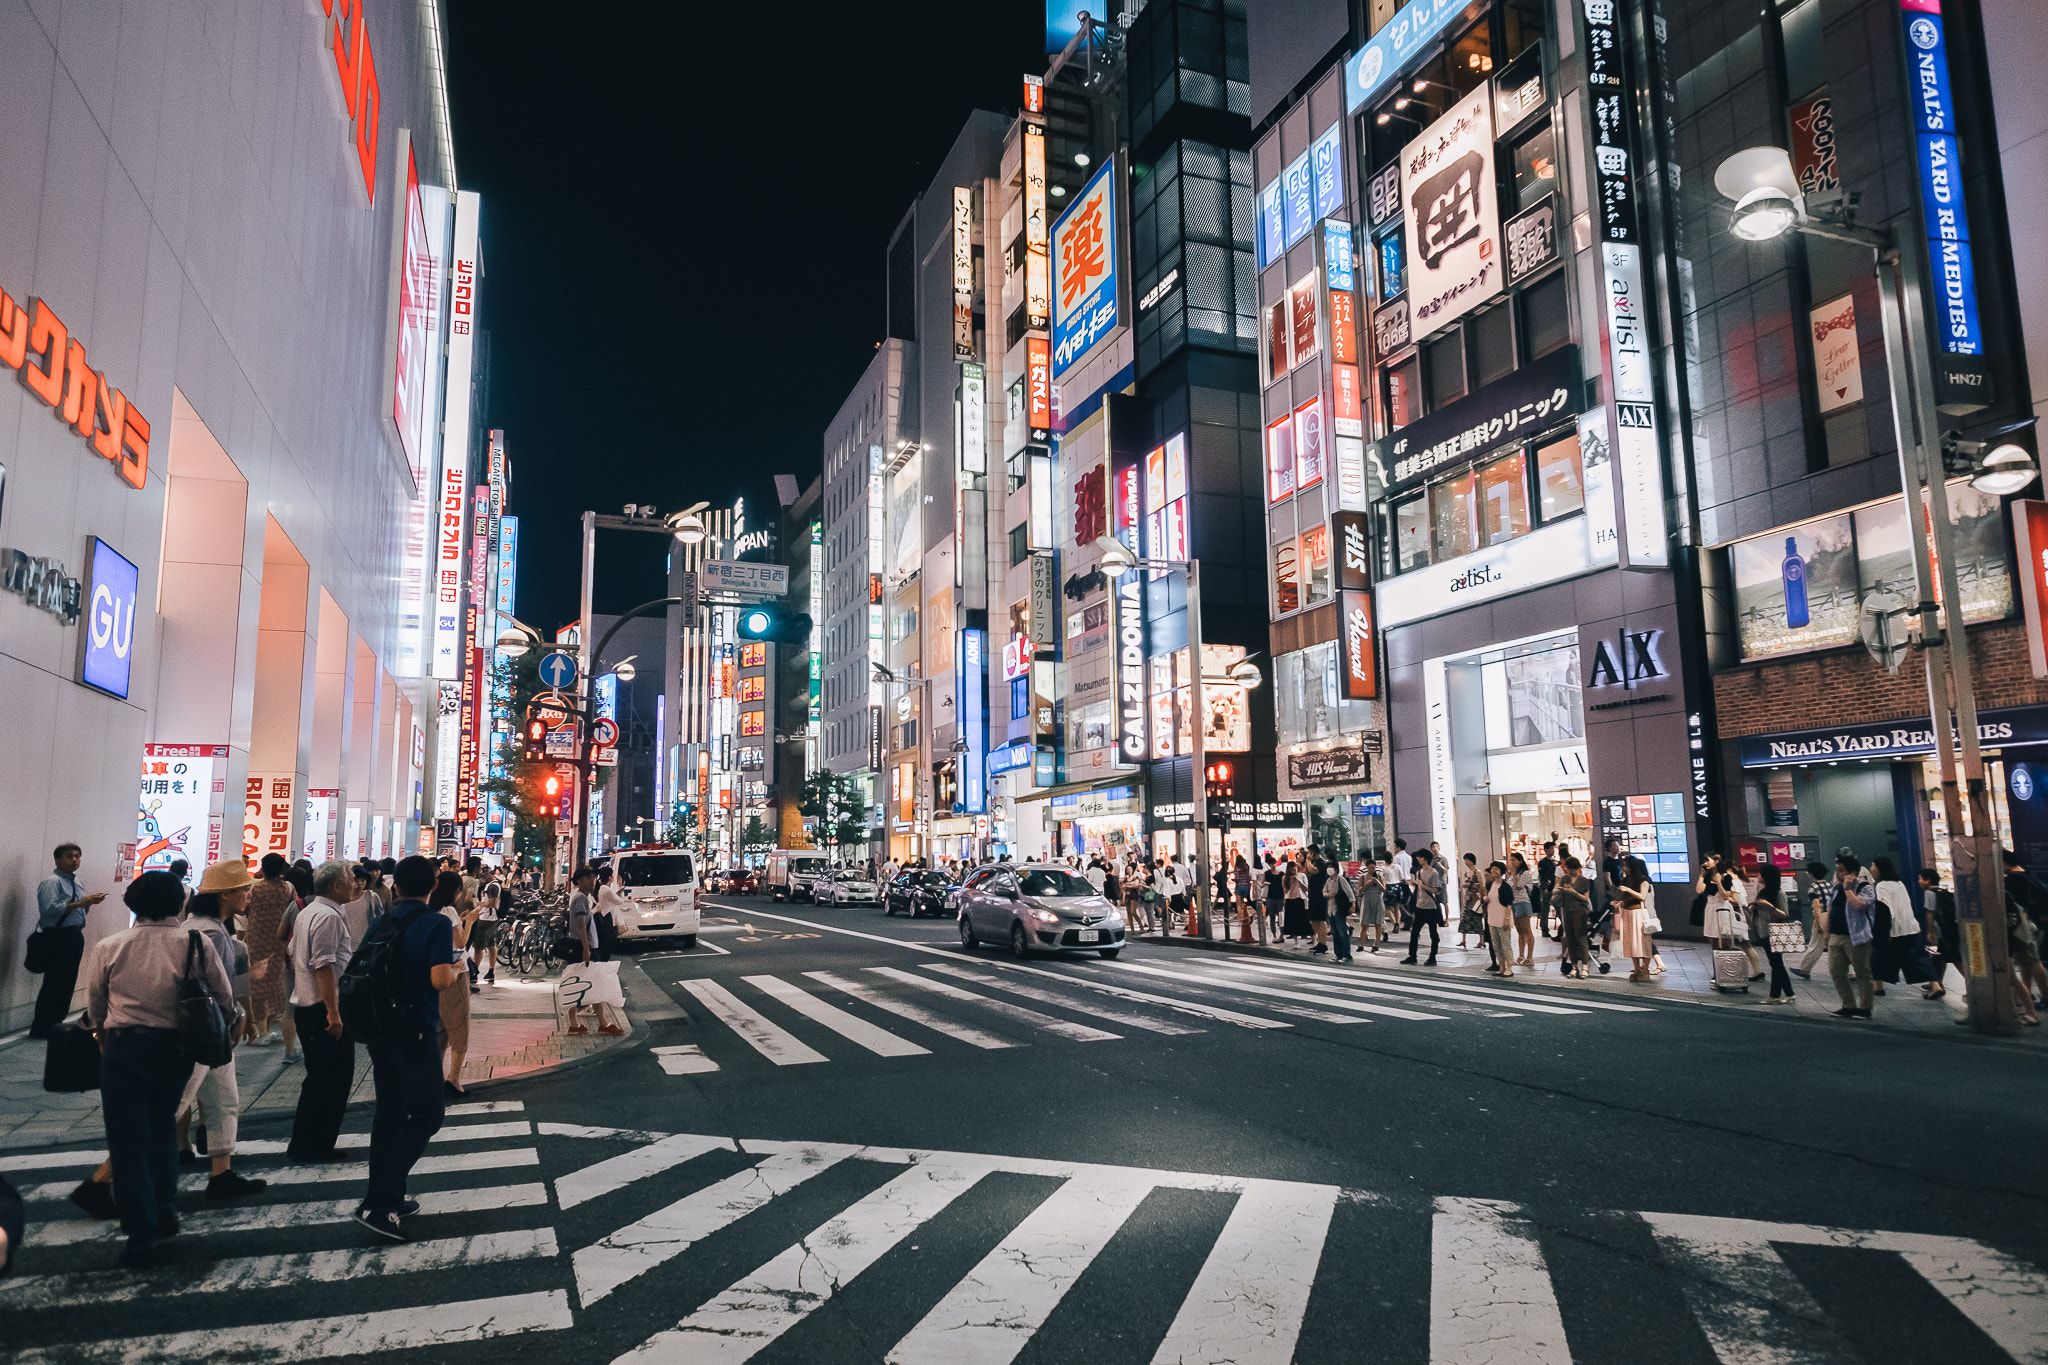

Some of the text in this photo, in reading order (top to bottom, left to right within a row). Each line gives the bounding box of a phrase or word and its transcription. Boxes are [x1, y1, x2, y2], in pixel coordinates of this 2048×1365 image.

[1590, 73, 1607, 84] 6F
[1027, 124, 1042, 135] 9F
[1918, 52, 1968, 339] NEAL'S YARD REMEDIES
[1611, 227, 1628, 239] 5F
[1061, 192, 1105, 309] 薬
[1327, 236, 1340, 285] イーオン
[1612, 254, 1629, 267] 3F
[1082, 289, 1102, 316] STORE
[1031, 315, 1046, 327] 9F
[1031, 366, 1047, 414] ガスト
[1341, 369, 1351, 416] 銀座カラー
[1950, 373, 1982, 387] HN27
[489, 449, 502, 553] MEGANE TOP SHINJUKU
[1126, 470, 1138, 525] LEGWEAR
[442, 468, 463, 561] ビックカメラ
[477, 539, 487, 582] BRAND
[1344, 522, 1367, 574] HIS
[707, 564, 785, 581] 新宿三丁目西
[721, 577, 751, 588] Shinjuku
[1033, 558, 1045, 642] みずのクリニック
[91, 584, 133, 659] GU
[440, 620, 455, 628] GU
[746, 656, 764, 665] BOOK
[967, 636, 978, 666] AOKI
[1121, 581, 1144, 757] CALZEDONIA
[745, 691, 764, 699] BOOK
[154, 745, 188, 757] Free
[1011, 746, 1028, 766] AOKI
[1770, 738, 1833, 759] NEAL'S
[1834, 735, 1890, 752] YARD
[1306, 761, 1324, 776] HIS
[244, 778, 263, 816] BIC
[440, 780, 449, 817] ROLEX
[1692, 757, 1709, 818] AKANE
